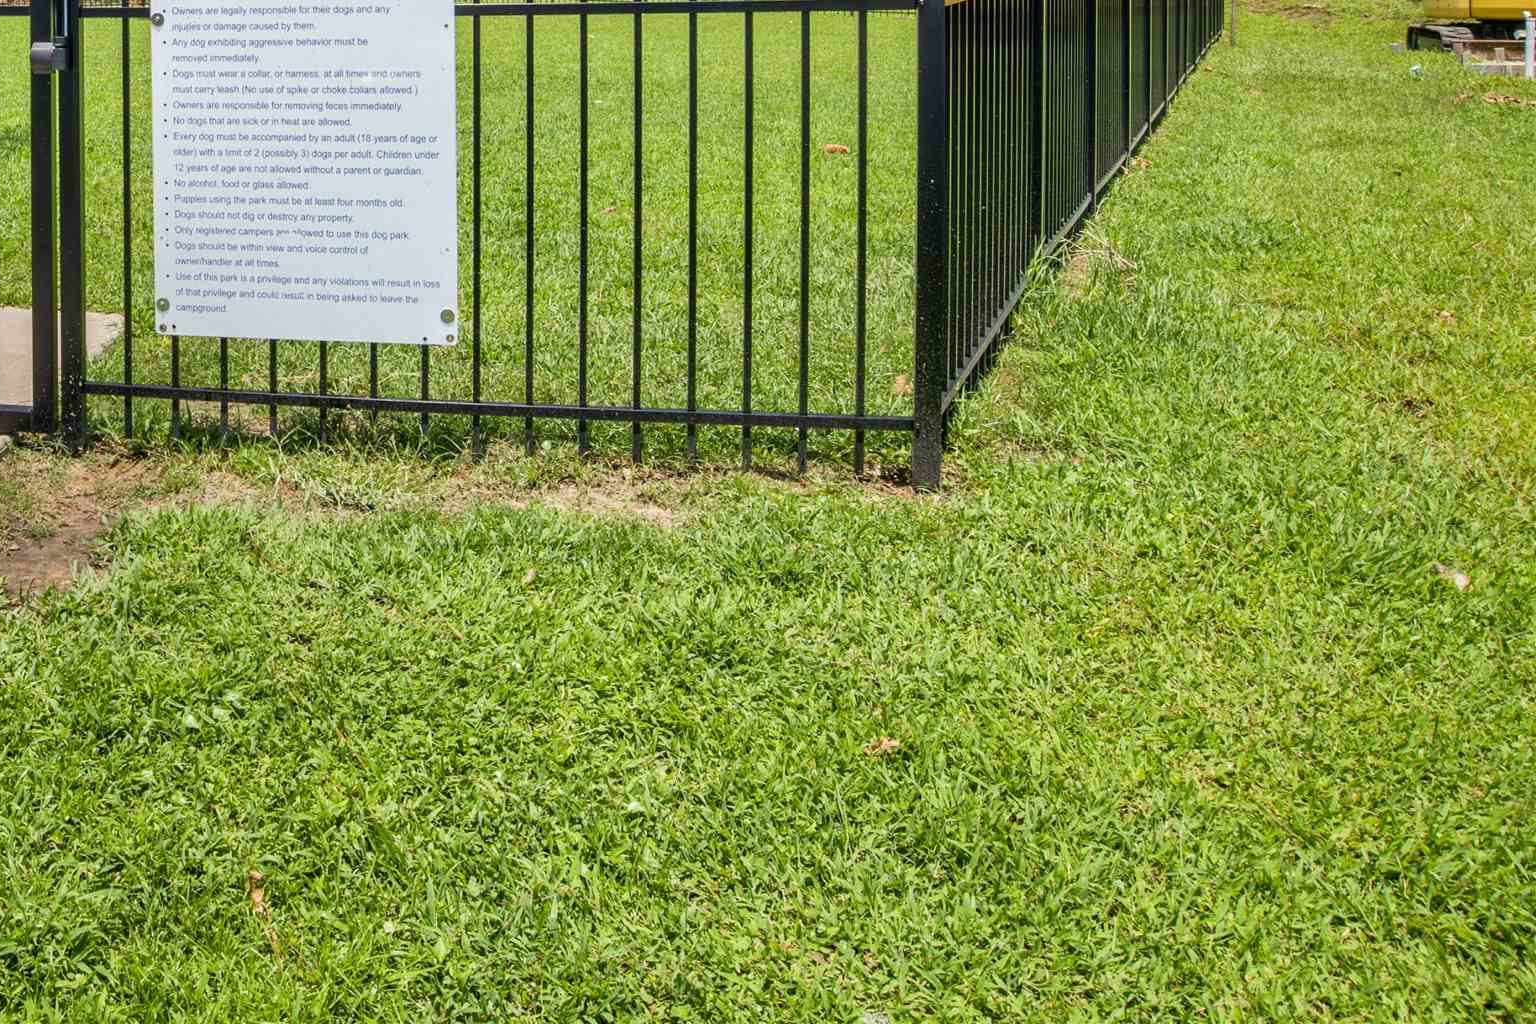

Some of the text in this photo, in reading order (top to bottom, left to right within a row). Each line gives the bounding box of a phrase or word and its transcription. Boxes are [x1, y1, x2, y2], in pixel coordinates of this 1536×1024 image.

[220, 6, 247, 16] legally
[249, 6, 296, 16] responsible
[332, 6, 354, 15] dogs
[374, 7, 390, 15] any
[212, 22, 246, 32] damage
[280, 22, 291, 31] by
[172, 38, 188, 47] Any
[189, 38, 205, 47] dog
[248, 38, 293, 47] aggressive
[172, 69, 193, 79] Dogs
[286, 86, 308, 95] spike
[221, 101, 269, 110] responsible
[284, 101, 323, 111] removing
[186, 116, 207, 126] dogs
[173, 132, 196, 141] Every
[198, 132, 214, 141] dog
[251, 133, 306, 143] accompanied
[308, 133, 319, 143] by
[334, 134, 355, 142] adult
[373, 136, 397, 144] years
[410, 136, 426, 144] age
[261, 148, 298, 158] (possibly
[311, 149, 332, 159] dogs
[334, 151, 348, 159] per
[376, 150, 412, 158] Children
[414, 151, 439, 159] under
[185, 164, 208, 173] years
[220, 165, 236, 173] age
[269, 164, 301, 173] allowed
[303, 165, 333, 173] without
[343, 166, 370, 175] parent
[252, 180, 274, 190] glass
[174, 194, 207, 204] Puppies
[248, 196, 266, 205] park
[268, 196, 289, 204] must
[314, 197, 334, 205] least
[336, 197, 353, 205] four
[355, 198, 387, 206] months
[174, 210, 196, 219] Dogs
[198, 210, 225, 218] should
[242, 211, 254, 221] dig
[267, 212, 298, 222] destroy
[300, 214, 315, 222] any
[174, 225, 193, 235] Only
[238, 228, 273, 237] campers
[353, 230, 369, 238] this
[371, 230, 387, 240] dog
[174, 241, 195, 250] Dogs
[197, 241, 225, 250] should
[286, 244, 302, 252] and
[304, 244, 327, 252] voice
[328, 245, 358, 253] control
[359, 246, 368, 254] of
[175, 272, 191, 280] Use
[203, 273, 218, 281] this
[219, 273, 238, 283] park
[256, 274, 291, 285] privilege
[293, 275, 309, 284] and
[311, 278, 327, 286] any
[329, 276, 369, 286] violations
[371, 278, 384, 286] will
[386, 278, 410, 287] result
[412, 279, 420, 287] in
[422, 280, 440, 288] loss
[185, 288, 200, 296] that
[202, 288, 237, 298] privilege
[238, 289, 254, 298] and
[316, 292, 339, 302] being
[341, 293, 367, 301] asked
[369, 294, 377, 302] to
[379, 294, 403, 303] leave
[405, 295, 418, 303] the
